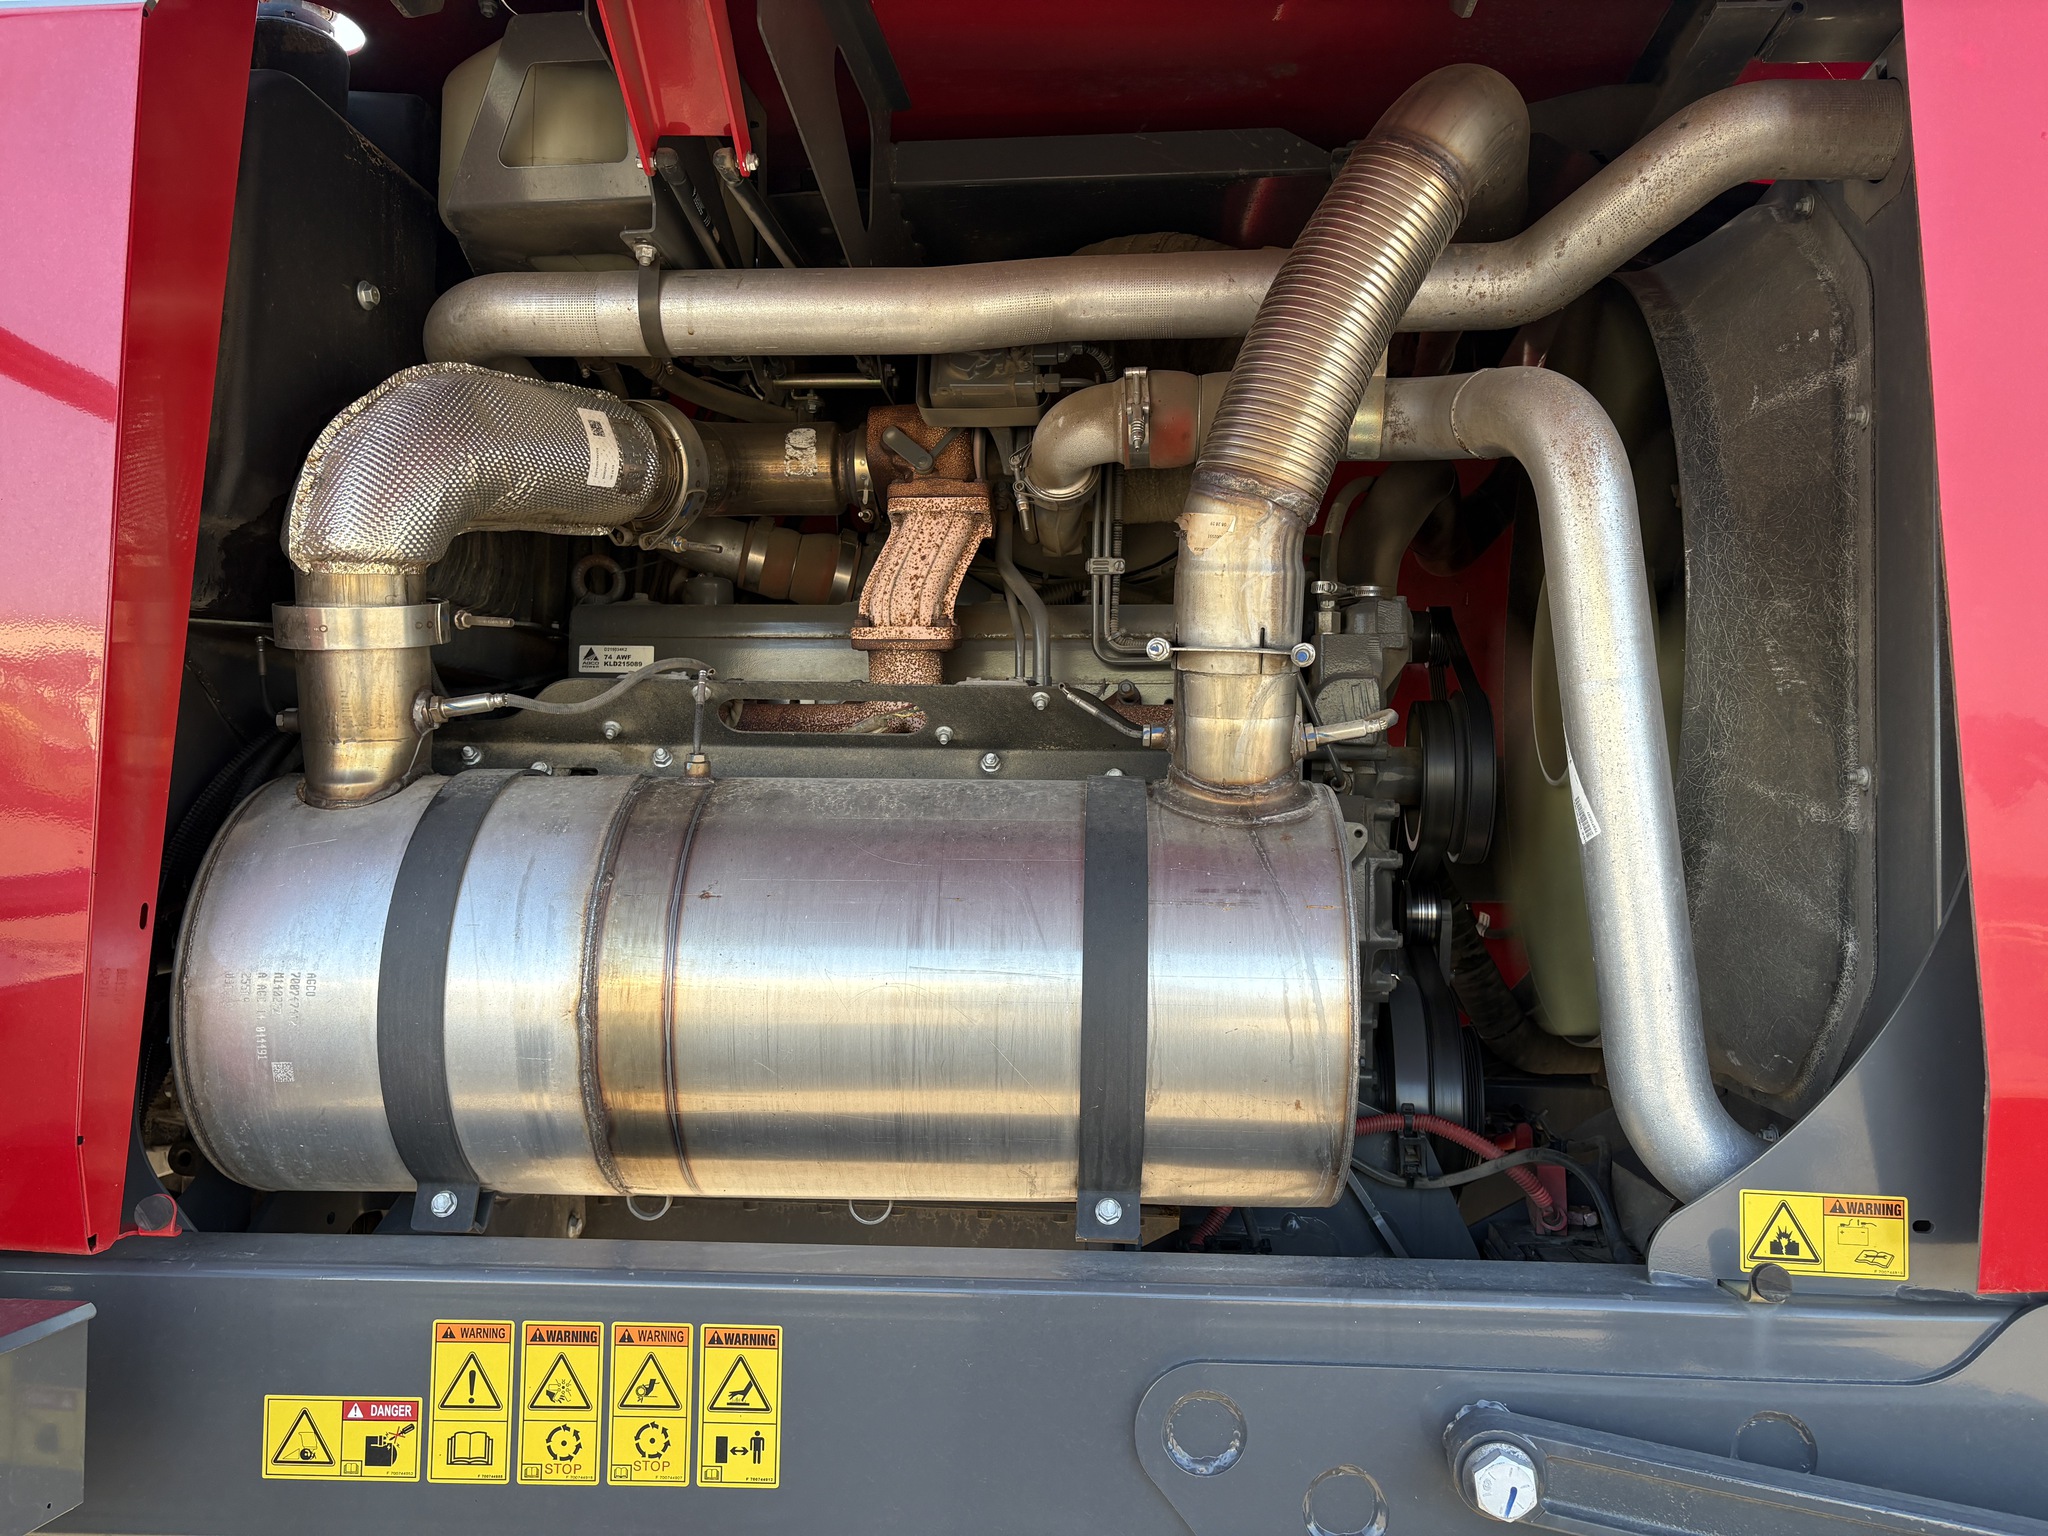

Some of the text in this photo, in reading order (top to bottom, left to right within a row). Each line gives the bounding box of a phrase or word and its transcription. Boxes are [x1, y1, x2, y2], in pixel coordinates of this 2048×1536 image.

[306, 972, 317, 997] AGCO
[1846, 1201, 1902, 1217] WARNING
[460, 1327, 506, 1340] WARNING
[546, 1330, 598, 1343] WARNING
[637, 1330, 685, 1343] WARNING
[724, 1333, 776, 1347] WARNING
[370, 1404, 412, 1417] DANGER
[544, 1463, 582, 1475] STOP
[633, 1460, 671, 1472] STOP
